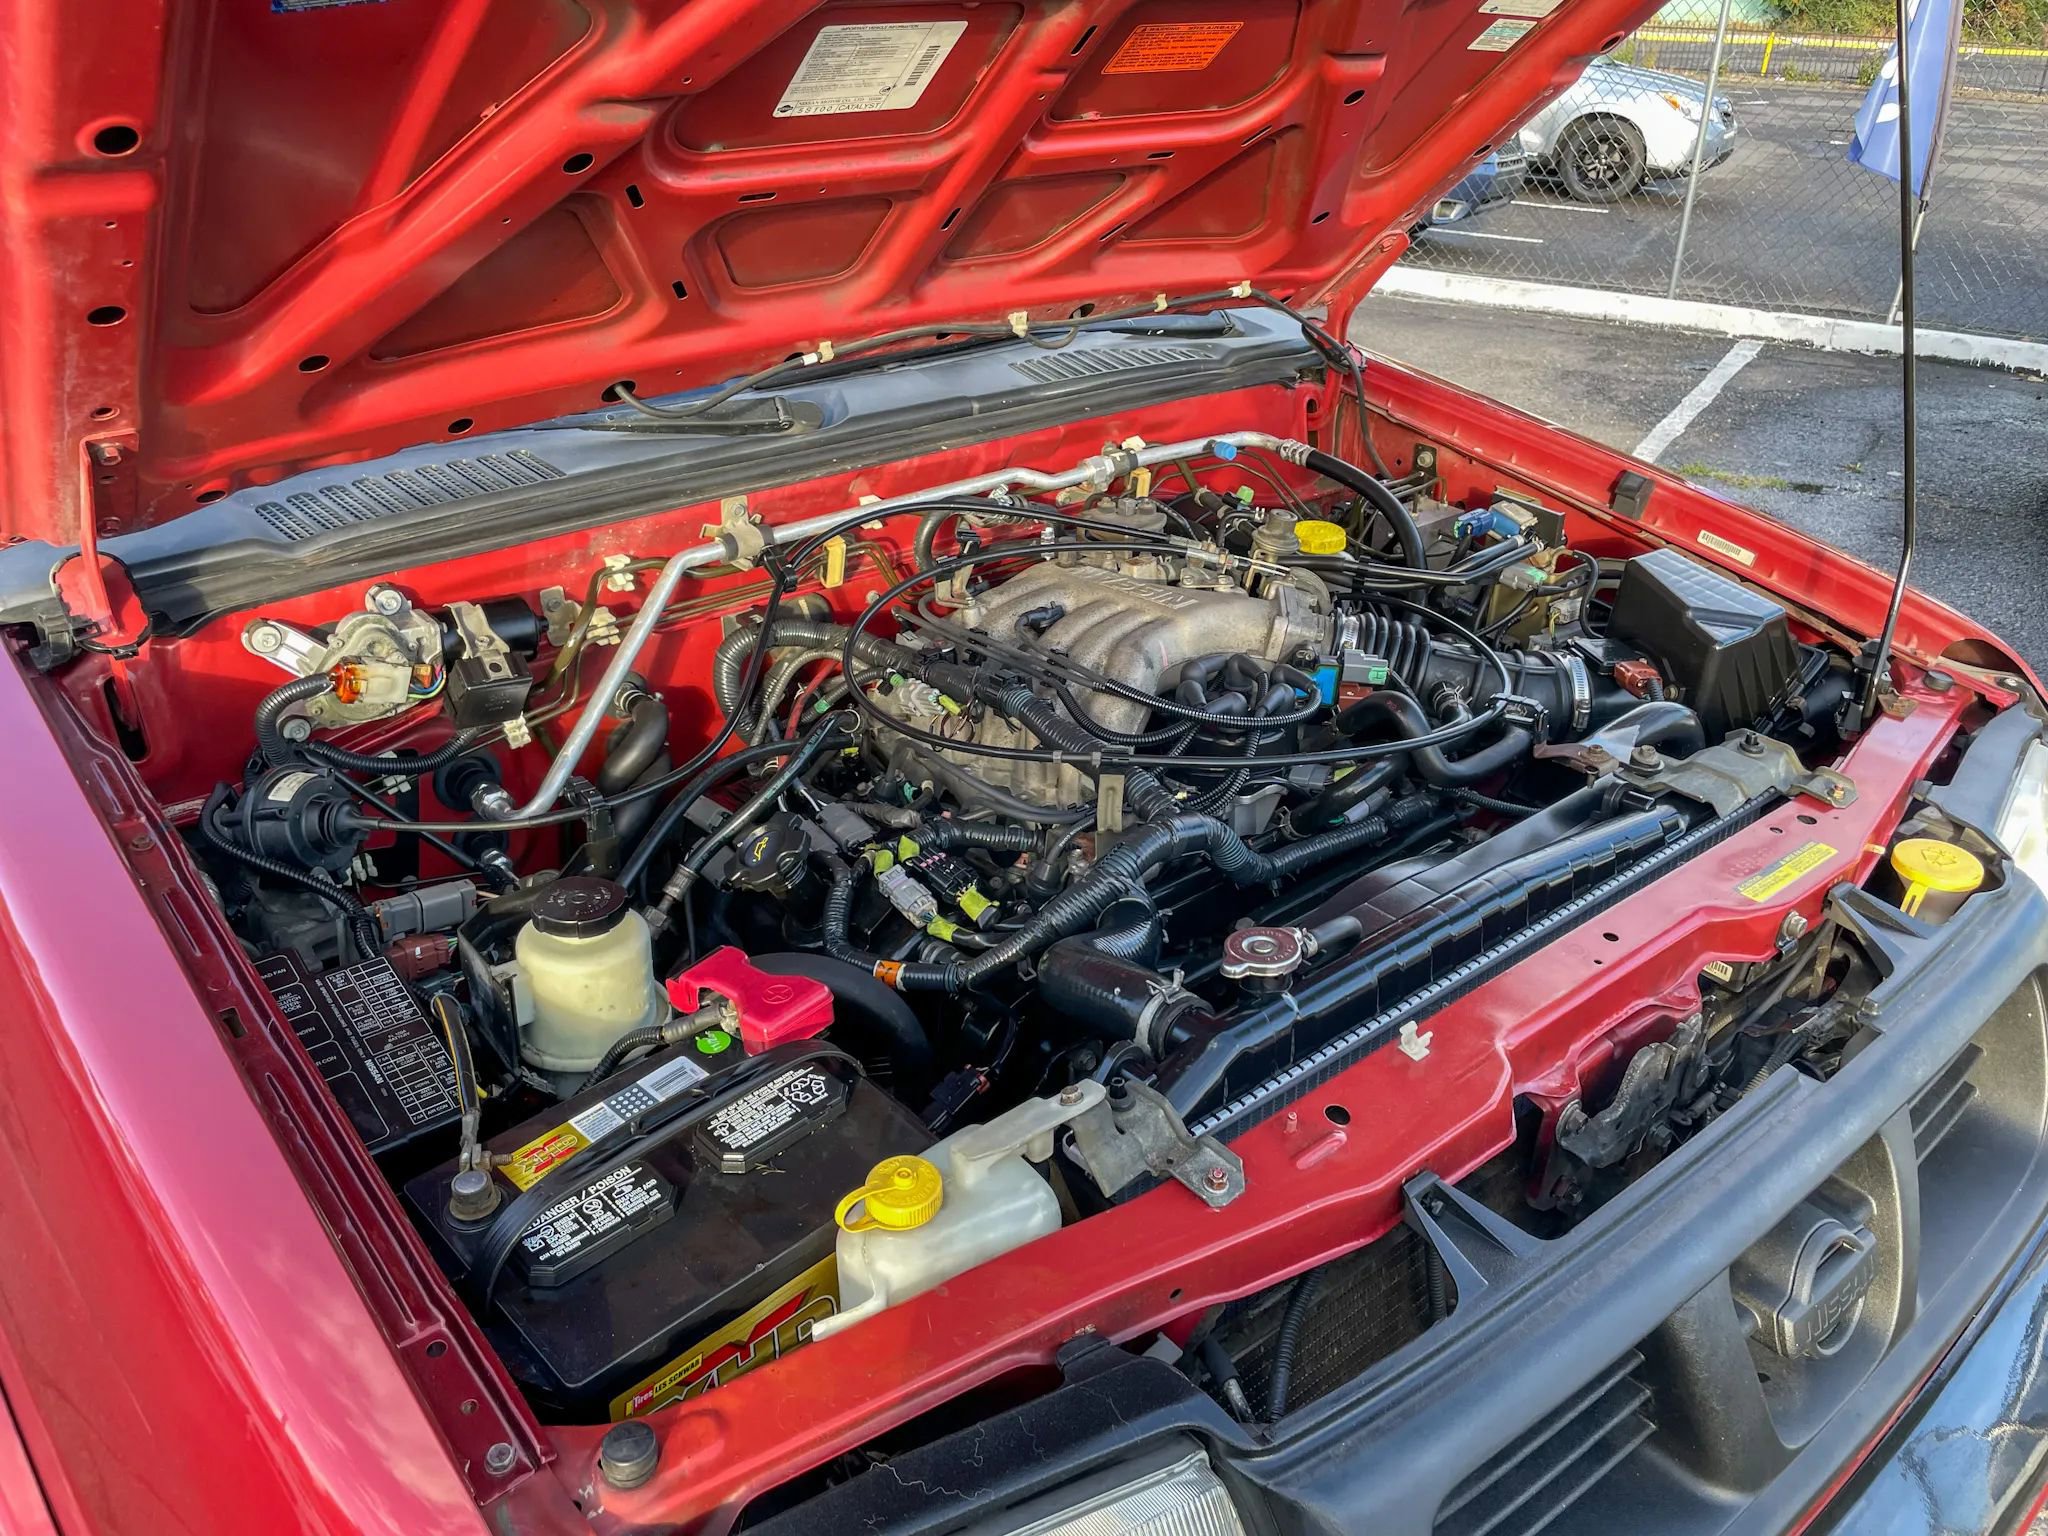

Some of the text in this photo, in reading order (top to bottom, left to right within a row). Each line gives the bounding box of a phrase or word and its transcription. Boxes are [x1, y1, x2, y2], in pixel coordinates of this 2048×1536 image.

[838, 102, 880, 111] CATALYST
[364, 1059, 384, 1085] NISSAN
[588, 1166, 632, 1194] POISON
[614, 1178, 658, 1204] SULFURIC ACID
[553, 1213, 575, 1227] SHIELD
[592, 1209, 604, 1218] NO
[546, 1223, 579, 1243] EXPLOSIVE
[557, 1220, 573, 1231] EYES
[551, 1234, 571, 1247] GASES
[634, 1358, 700, 1408] Tires LES SCHWAB
